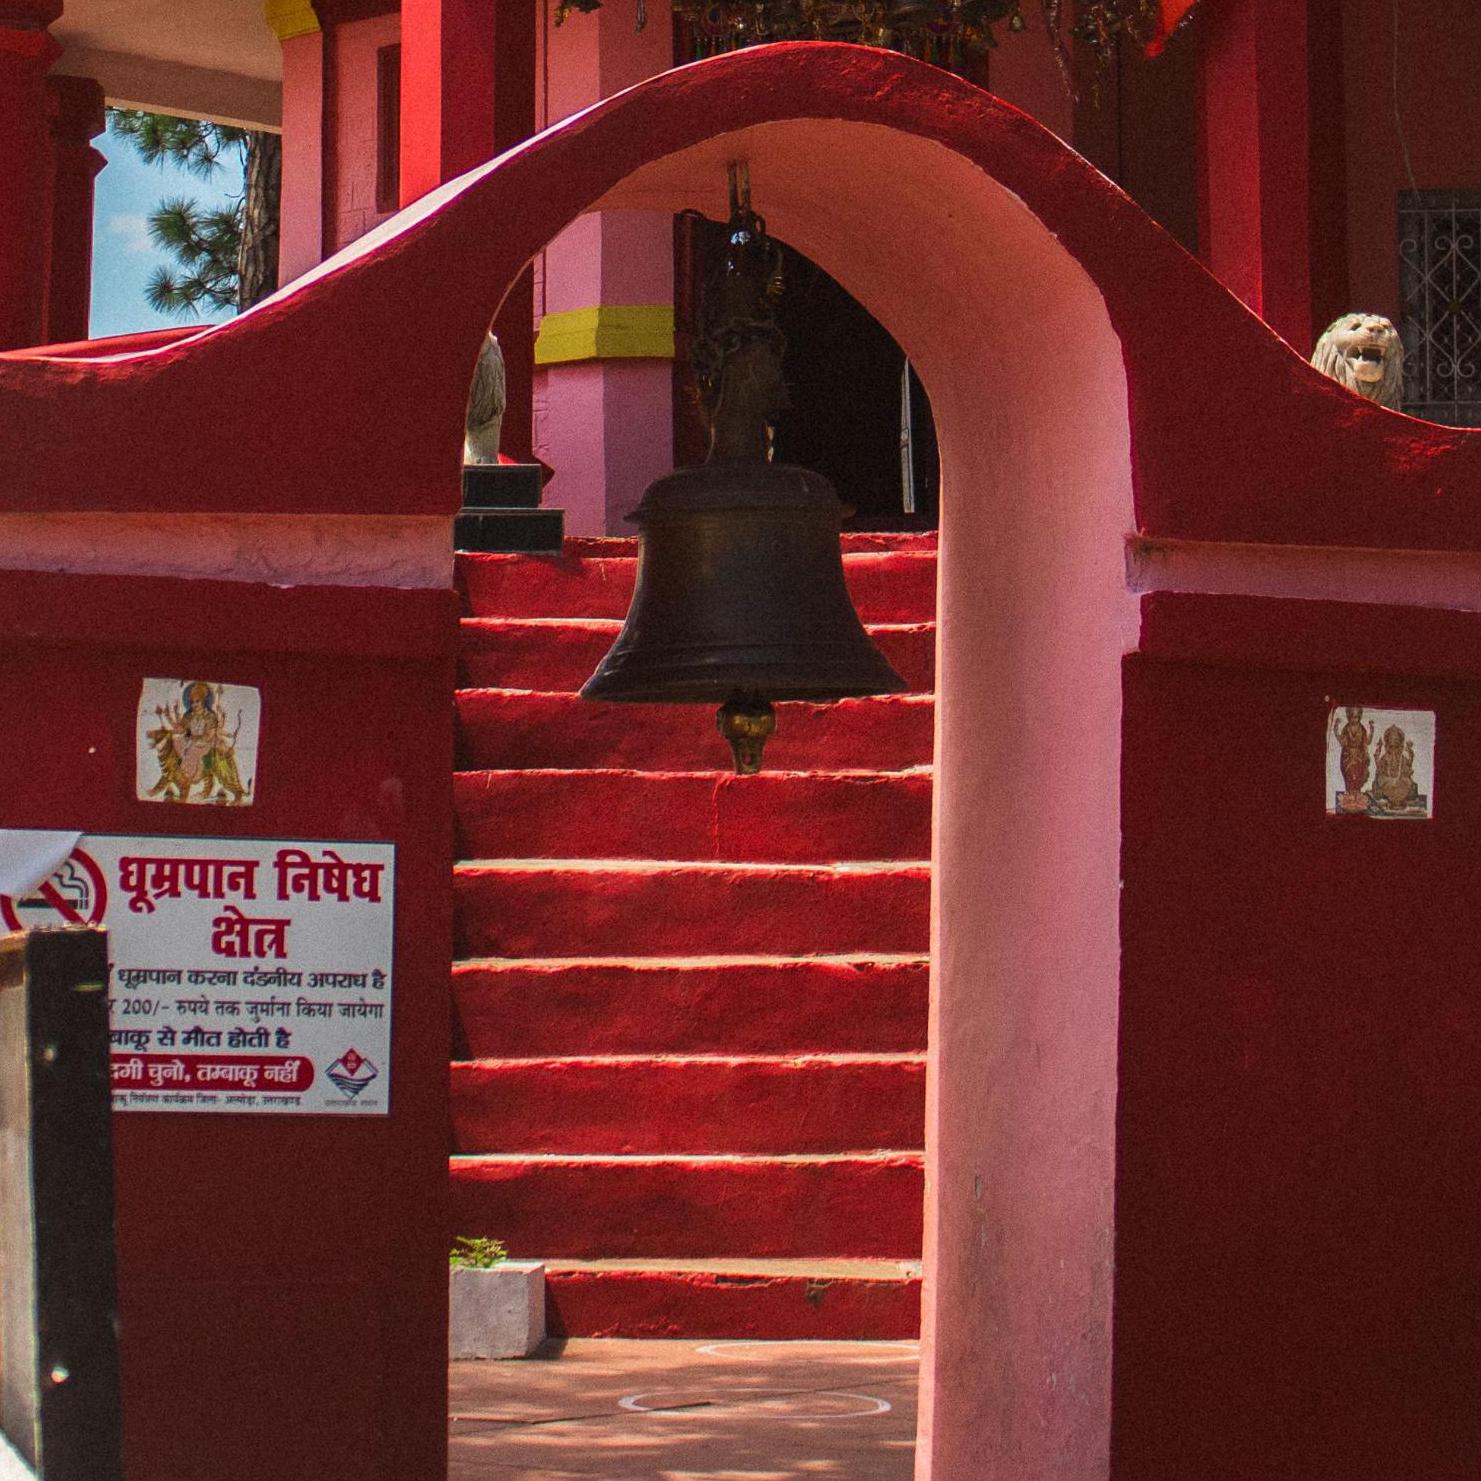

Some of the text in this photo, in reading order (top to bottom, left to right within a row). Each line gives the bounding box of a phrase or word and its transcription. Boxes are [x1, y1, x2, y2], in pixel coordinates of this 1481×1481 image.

[119, 849, 385, 914] धूम्रपान निषेध
[211, 905, 291, 959] क्षेत्र
[118, 968, 182, 990] धूम्रपान
[187, 969, 238, 986] करना
[243, 966, 303, 987] दंडनीय
[308, 972, 368, 989] अपराध
[372, 968, 387, 990] है
[122, 998, 170, 1016] 200/-
[175, 995, 209, 1015] रुपये
[214, 1000, 240, 1016] तक
[245, 995, 291, 1023] जुर्माना
[296, 996, 333, 1018] किया
[337, 997, 385, 1019] जायेगा
[157, 1026, 177, 1046] से
[182, 1026, 223, 1047] मौत
[227, 1026, 270, 1048] होती
[275, 1026, 292, 1049] है
[147, 1059, 191, 1086] चुनो,
[196, 1064, 260, 1088] तम्बाकू
[263, 1059, 301, 1083] नहीं
